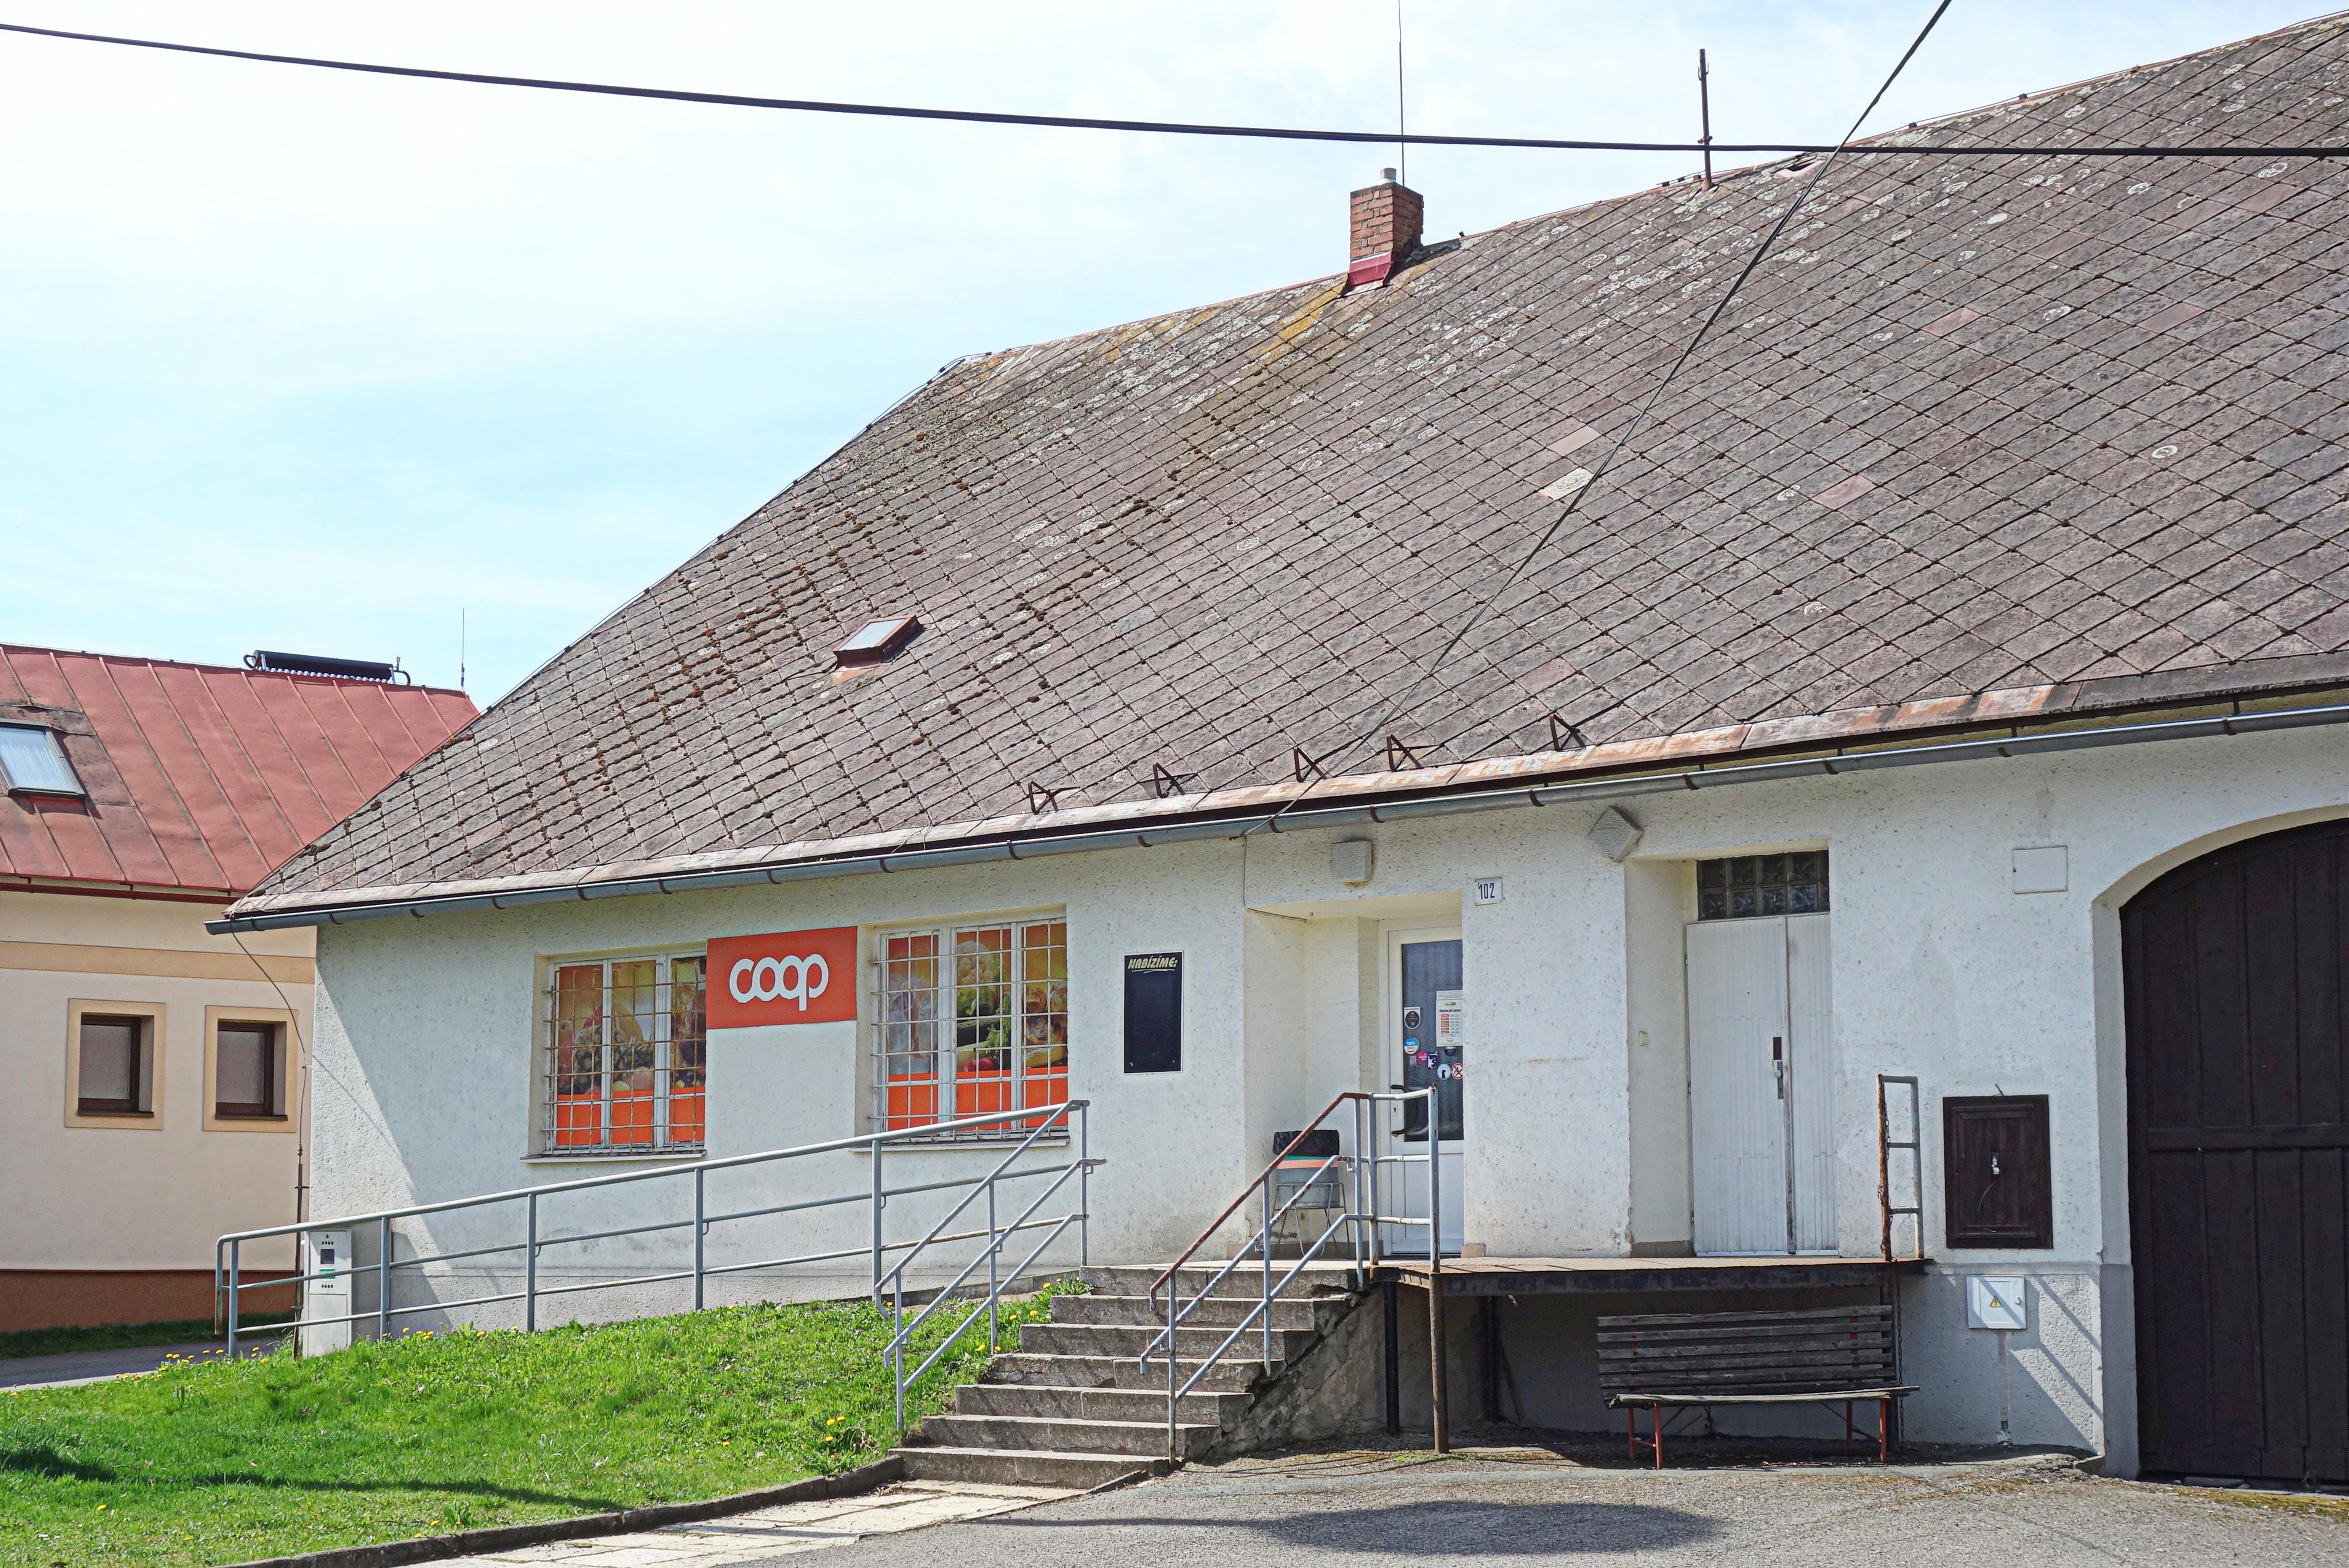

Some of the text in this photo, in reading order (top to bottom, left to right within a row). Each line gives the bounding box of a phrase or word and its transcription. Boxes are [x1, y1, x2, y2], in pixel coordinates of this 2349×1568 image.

[1478, 883, 1495, 900] 102
[1128, 955, 1178, 969] NABÍZÍME:
[729, 953, 829, 1011] coop
